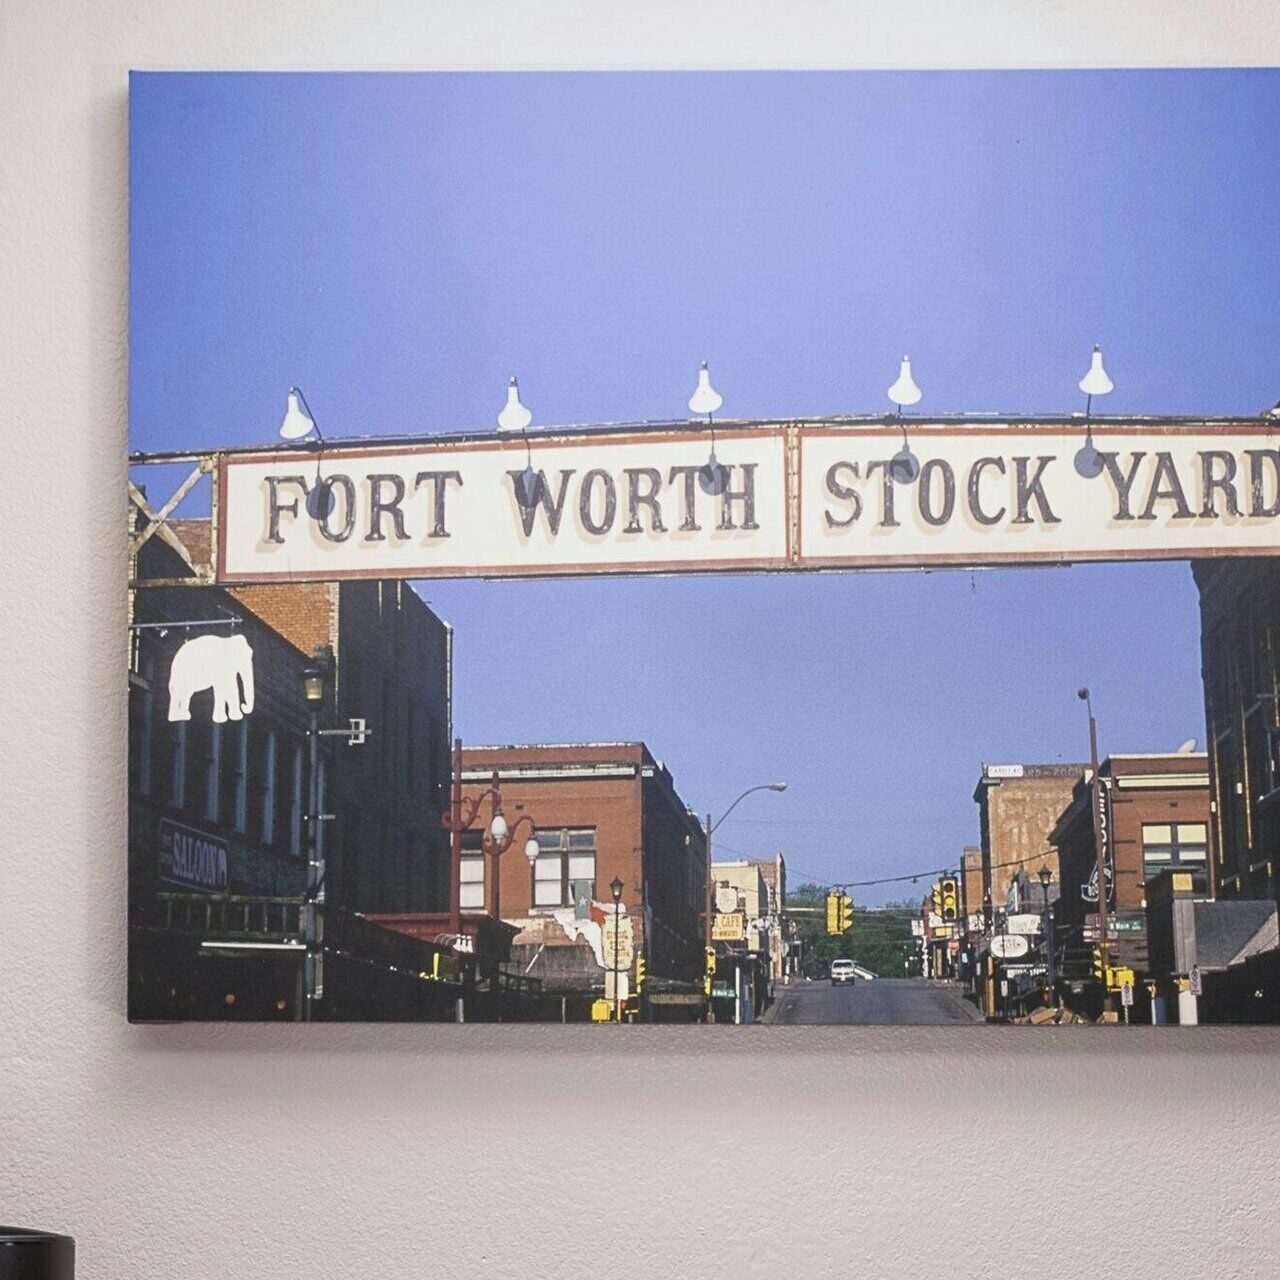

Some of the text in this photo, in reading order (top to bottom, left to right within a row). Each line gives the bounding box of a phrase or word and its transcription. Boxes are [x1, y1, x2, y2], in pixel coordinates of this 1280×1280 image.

[262, 470, 464, 545] FORT
[505, 461, 760, 538] WORTH
[823, 455, 1063, 529] STOCK
